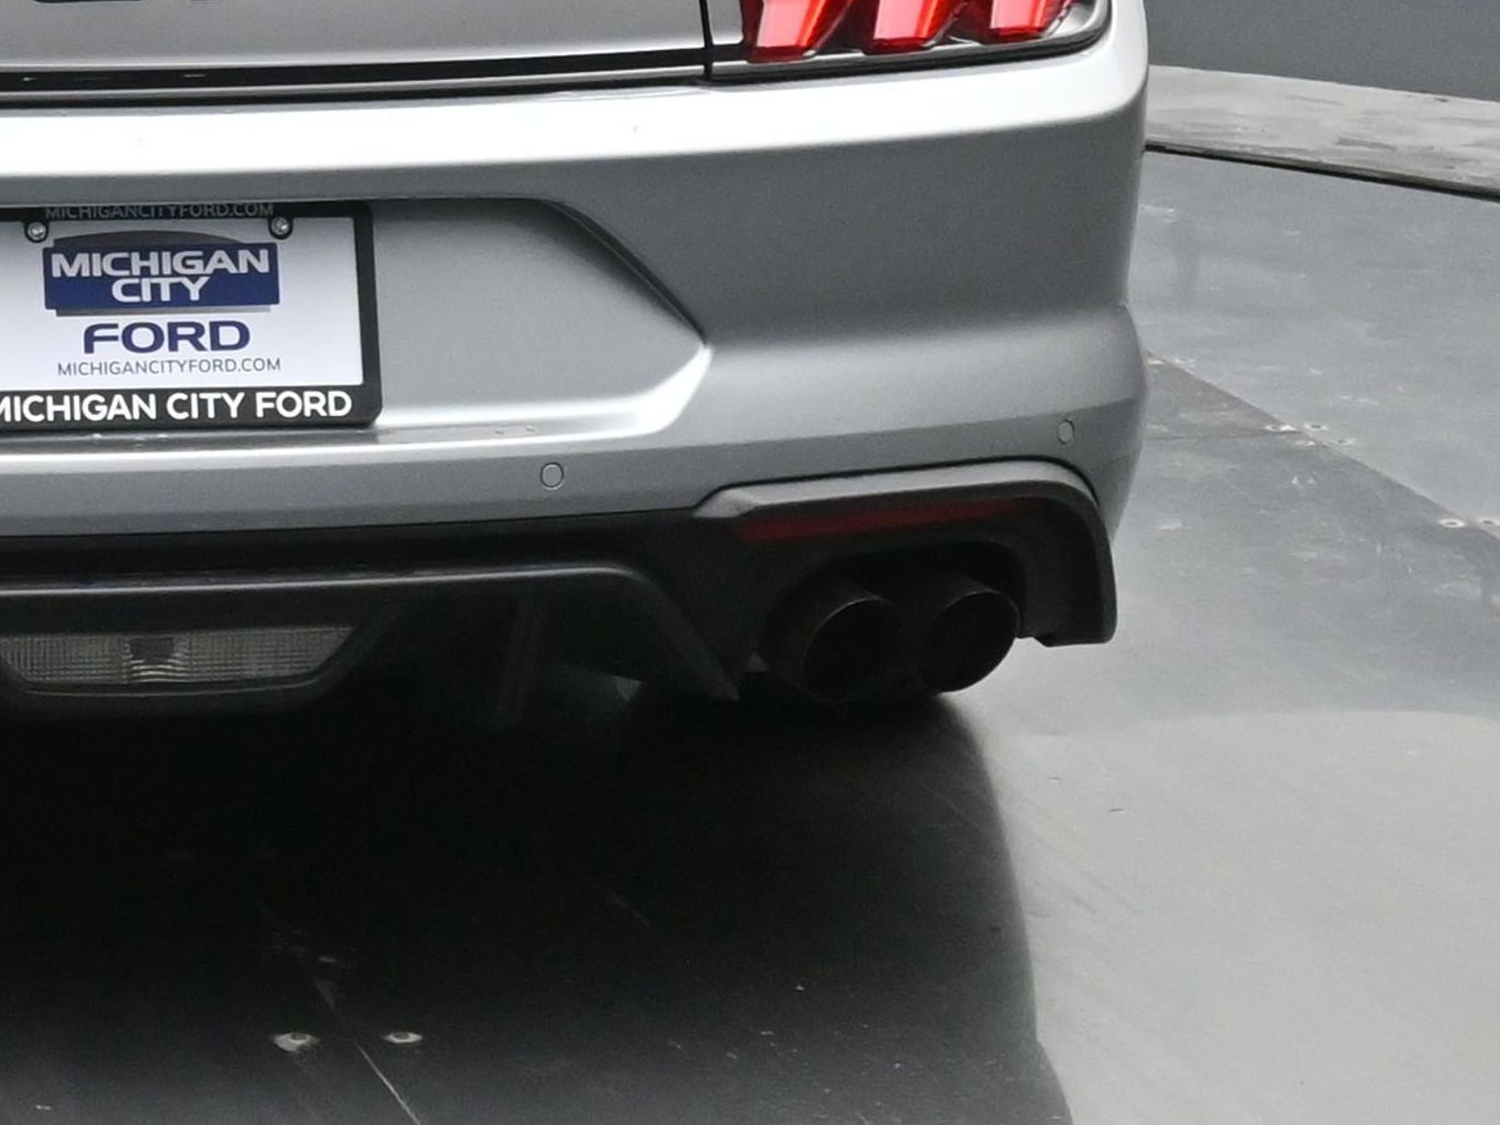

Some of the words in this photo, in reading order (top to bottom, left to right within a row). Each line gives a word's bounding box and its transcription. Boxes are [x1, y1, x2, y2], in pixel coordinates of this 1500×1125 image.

[45, 203, 274, 220] MICHIGANCITYFORD.COM
[50, 249, 269, 277] MICHIGAN
[111, 276, 211, 303] CITY
[83, 320, 251, 354] FORD
[56, 357, 282, 376] MICHIGANCITYFORD.COM
[166, 391, 244, 420] CITY
[256, 390, 352, 419] FORD
